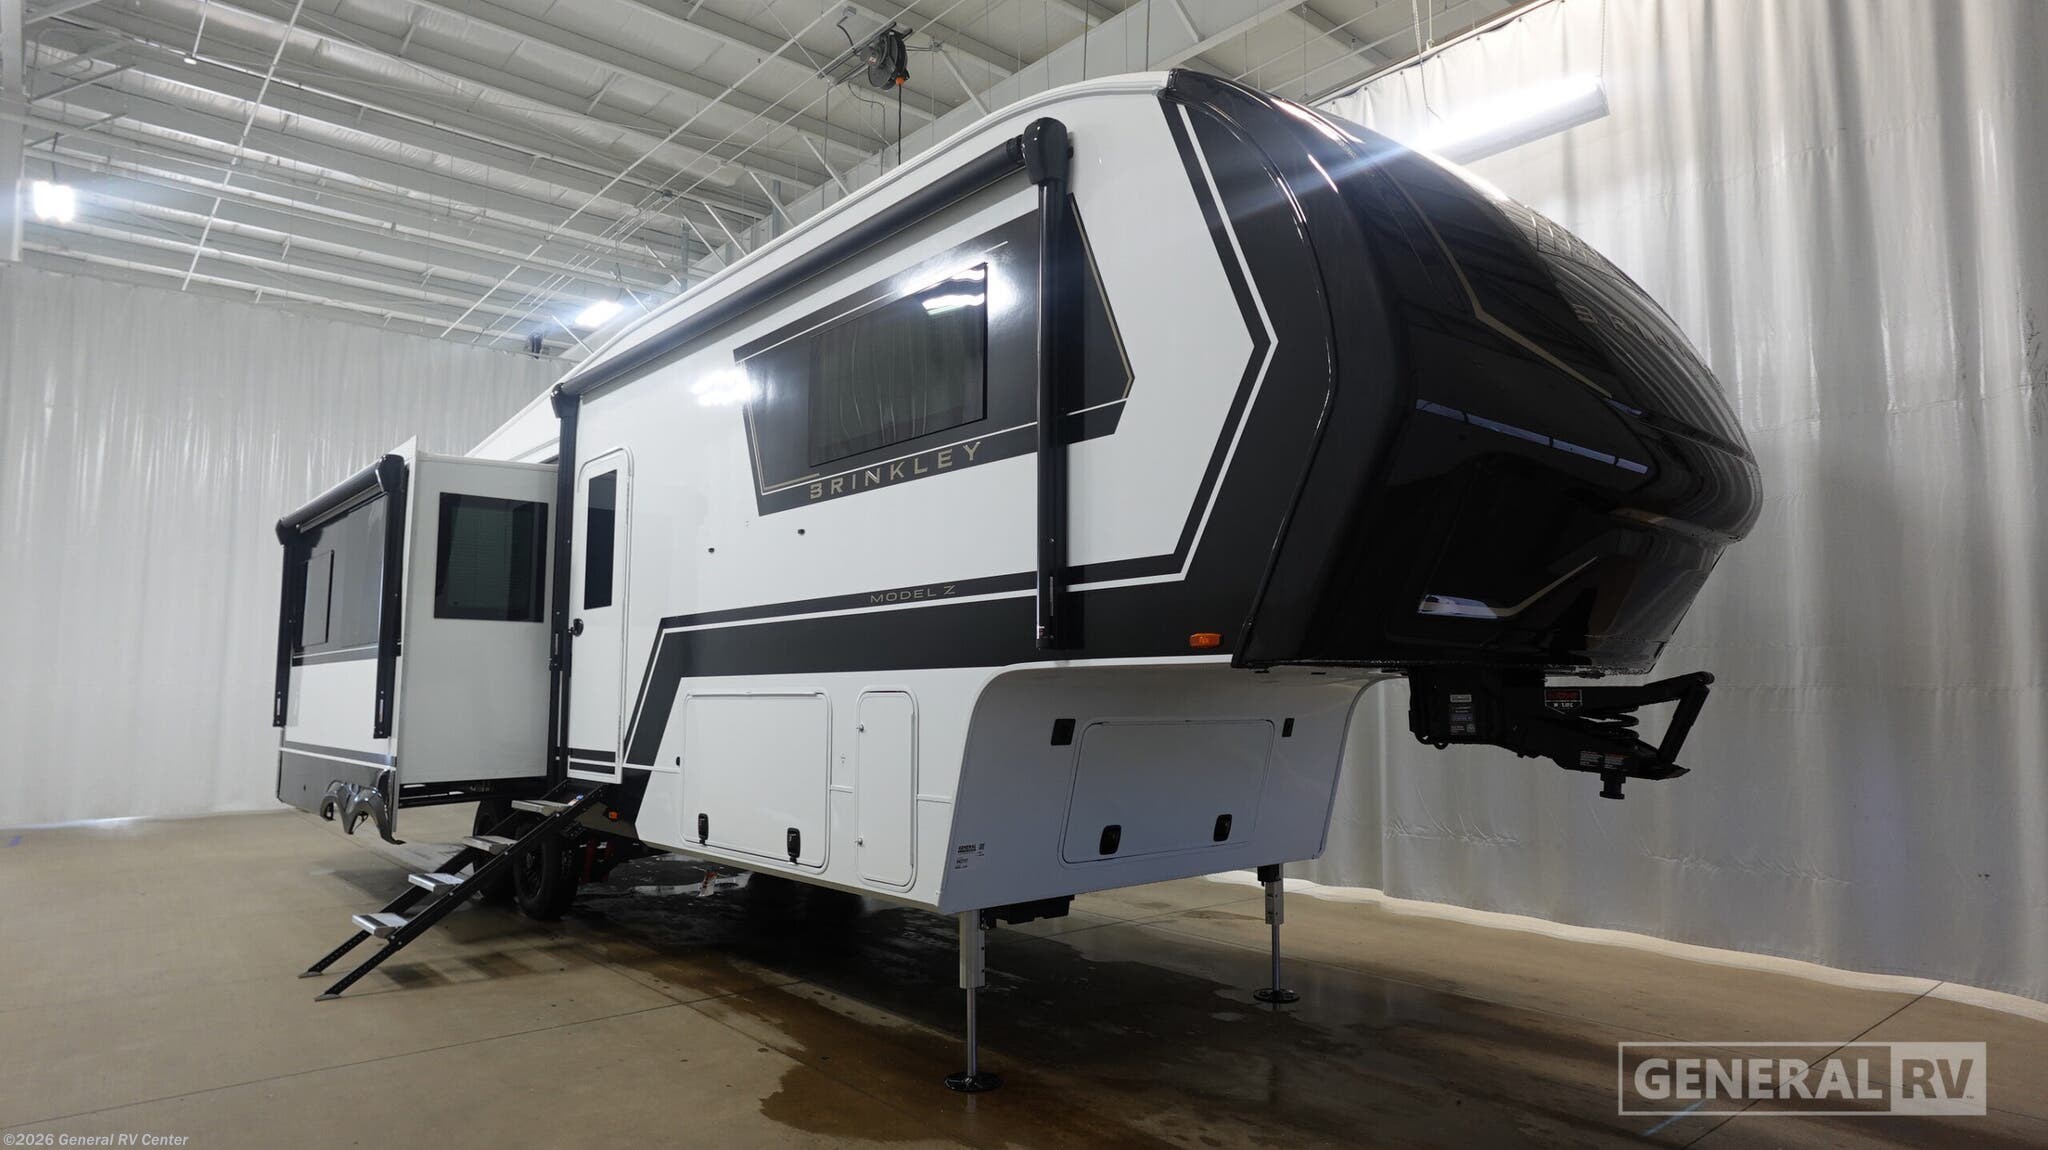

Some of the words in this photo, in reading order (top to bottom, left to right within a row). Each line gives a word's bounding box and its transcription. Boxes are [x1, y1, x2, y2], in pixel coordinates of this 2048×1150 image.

[810, 441, 981, 500] BRINKLEY
[870, 588, 937, 604] MODEL
[943, 584, 956, 595] Z
